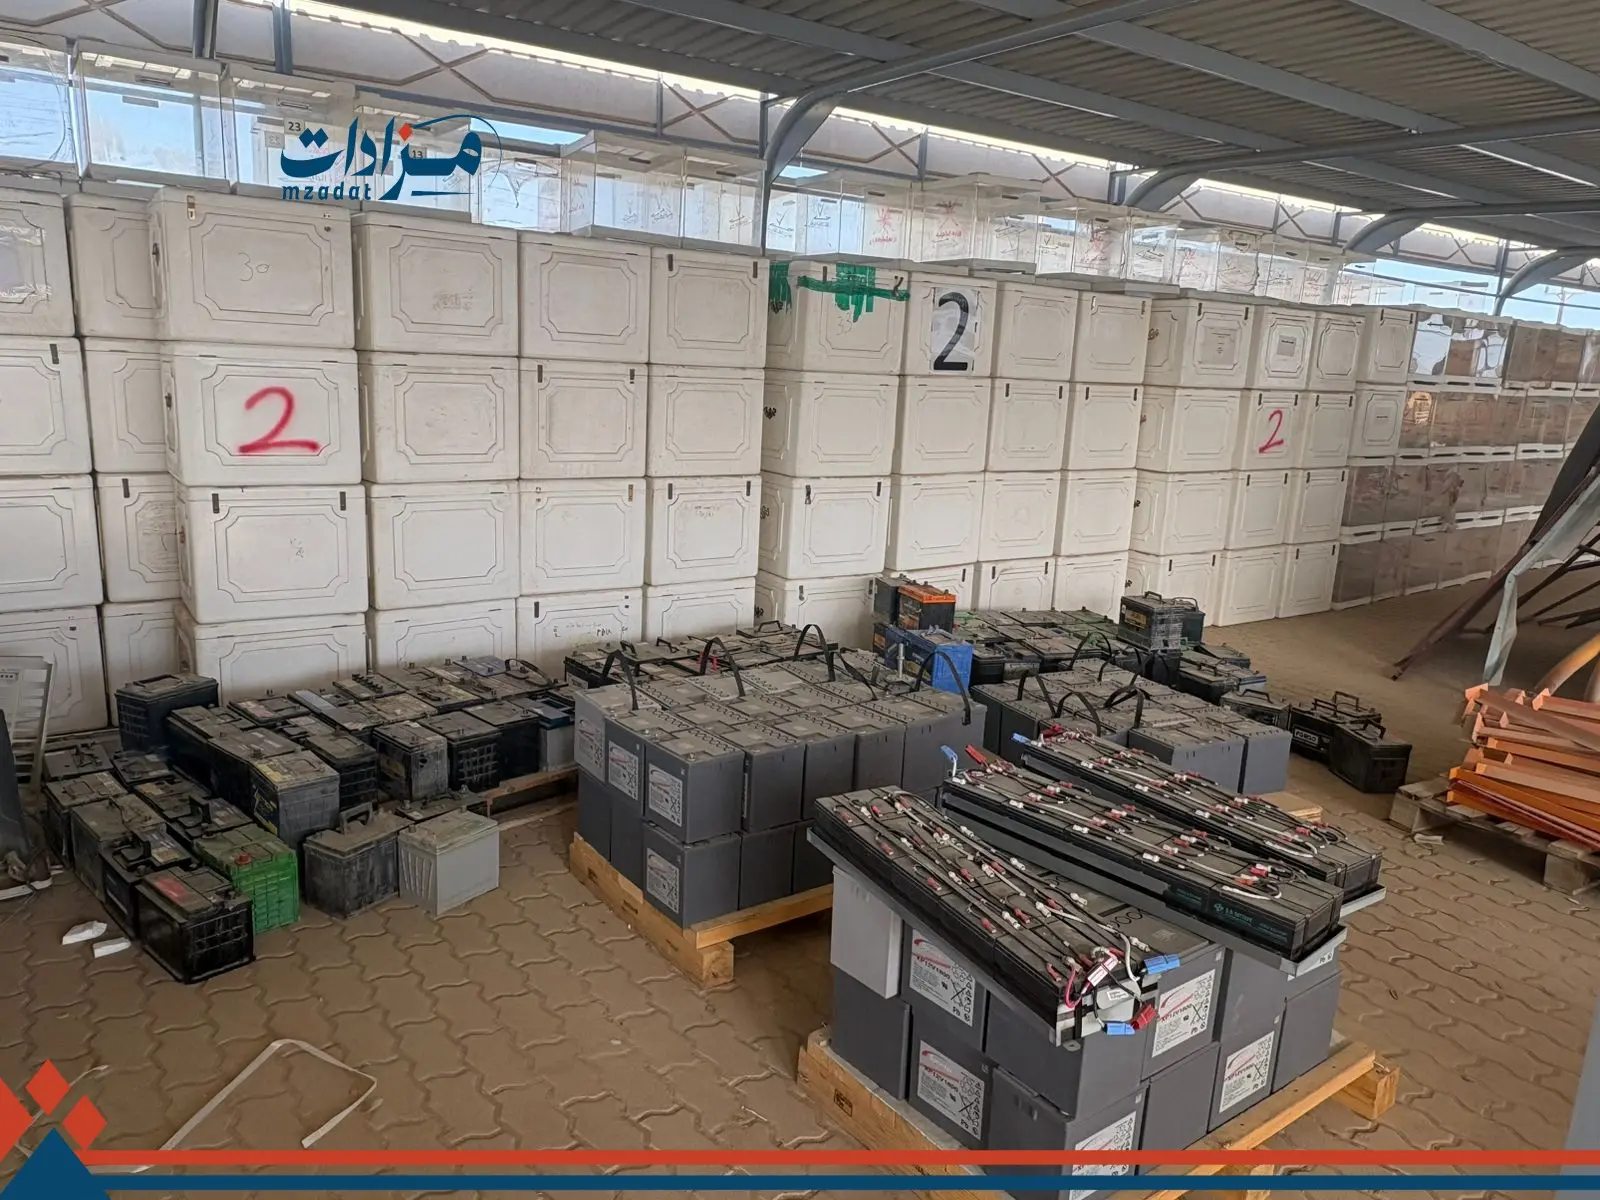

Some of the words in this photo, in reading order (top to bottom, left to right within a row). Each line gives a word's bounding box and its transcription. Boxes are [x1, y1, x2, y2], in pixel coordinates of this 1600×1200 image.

[288, 121, 302, 132] 23
[412, 149, 424, 159] 13
[933, 291, 969, 371] 2
[238, 386, 320, 455] 2
[1258, 409, 1285, 455] 2
